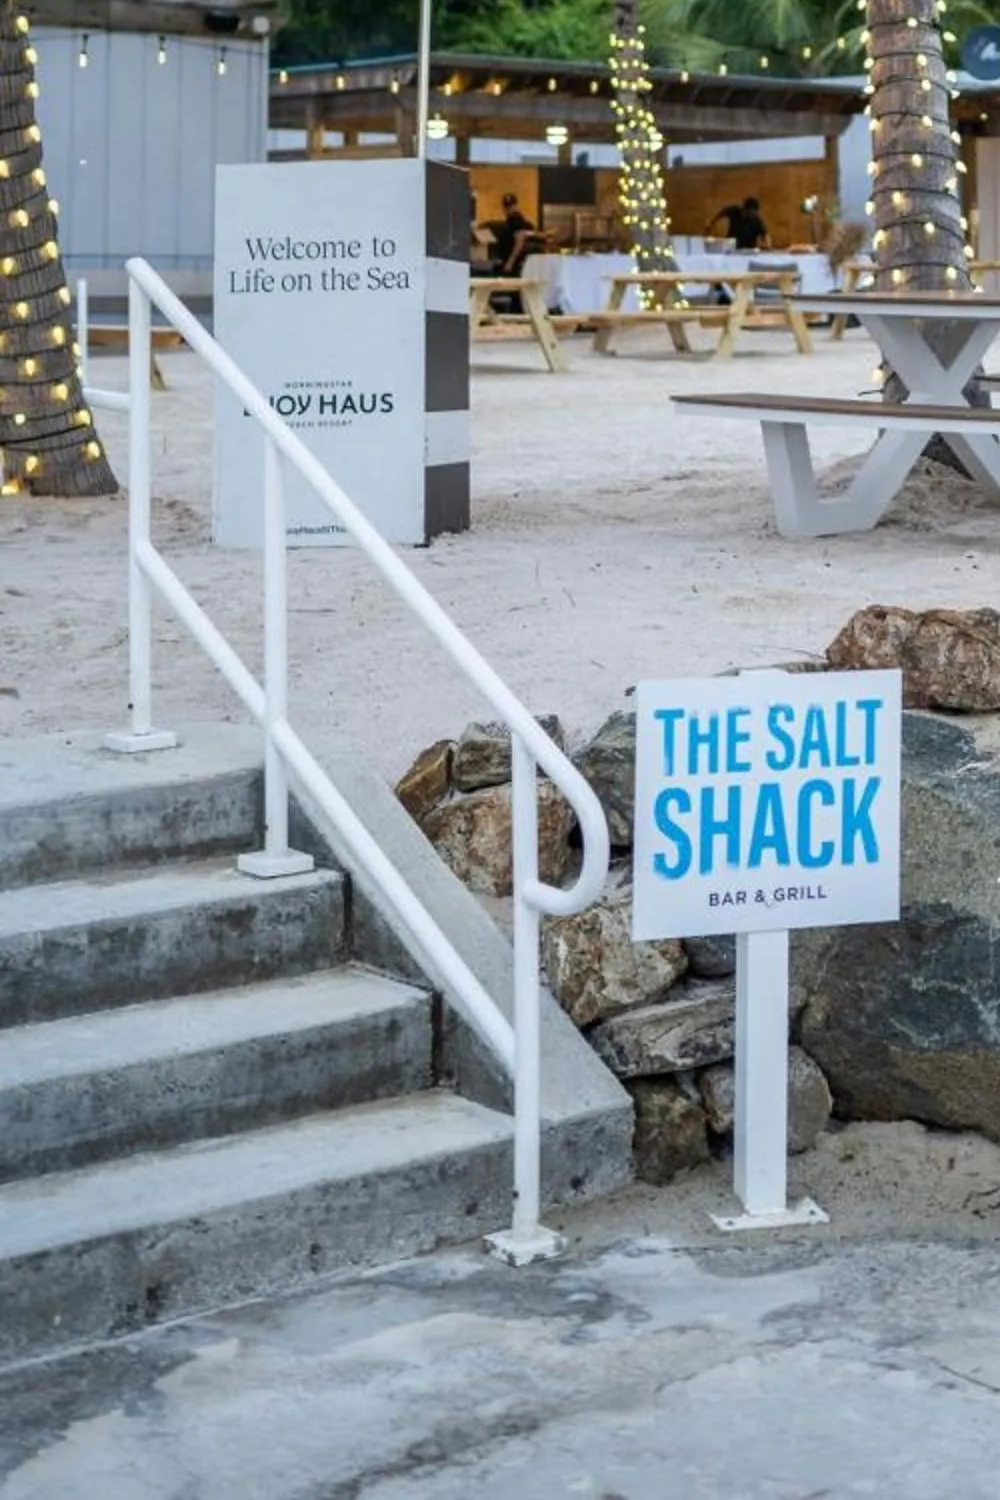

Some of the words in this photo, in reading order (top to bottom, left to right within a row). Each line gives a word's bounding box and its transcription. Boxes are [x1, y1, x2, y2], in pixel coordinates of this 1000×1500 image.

[245, 236, 361, 260] Welcome
[372, 236, 396, 258] to
[229, 268, 275, 293] Life
[281, 273, 312, 292] on
[321, 267, 361, 291] the
[367, 266, 409, 290] Sea
[319, 393, 394, 415] HAUS
[653, 708, 752, 776] THE
[765, 699, 883, 771] SALT
[653, 777, 880, 880] SHACK
[708, 891, 747, 907] BAR
[754, 889, 766, 903] &
[773, 885, 828, 902] GRILL
